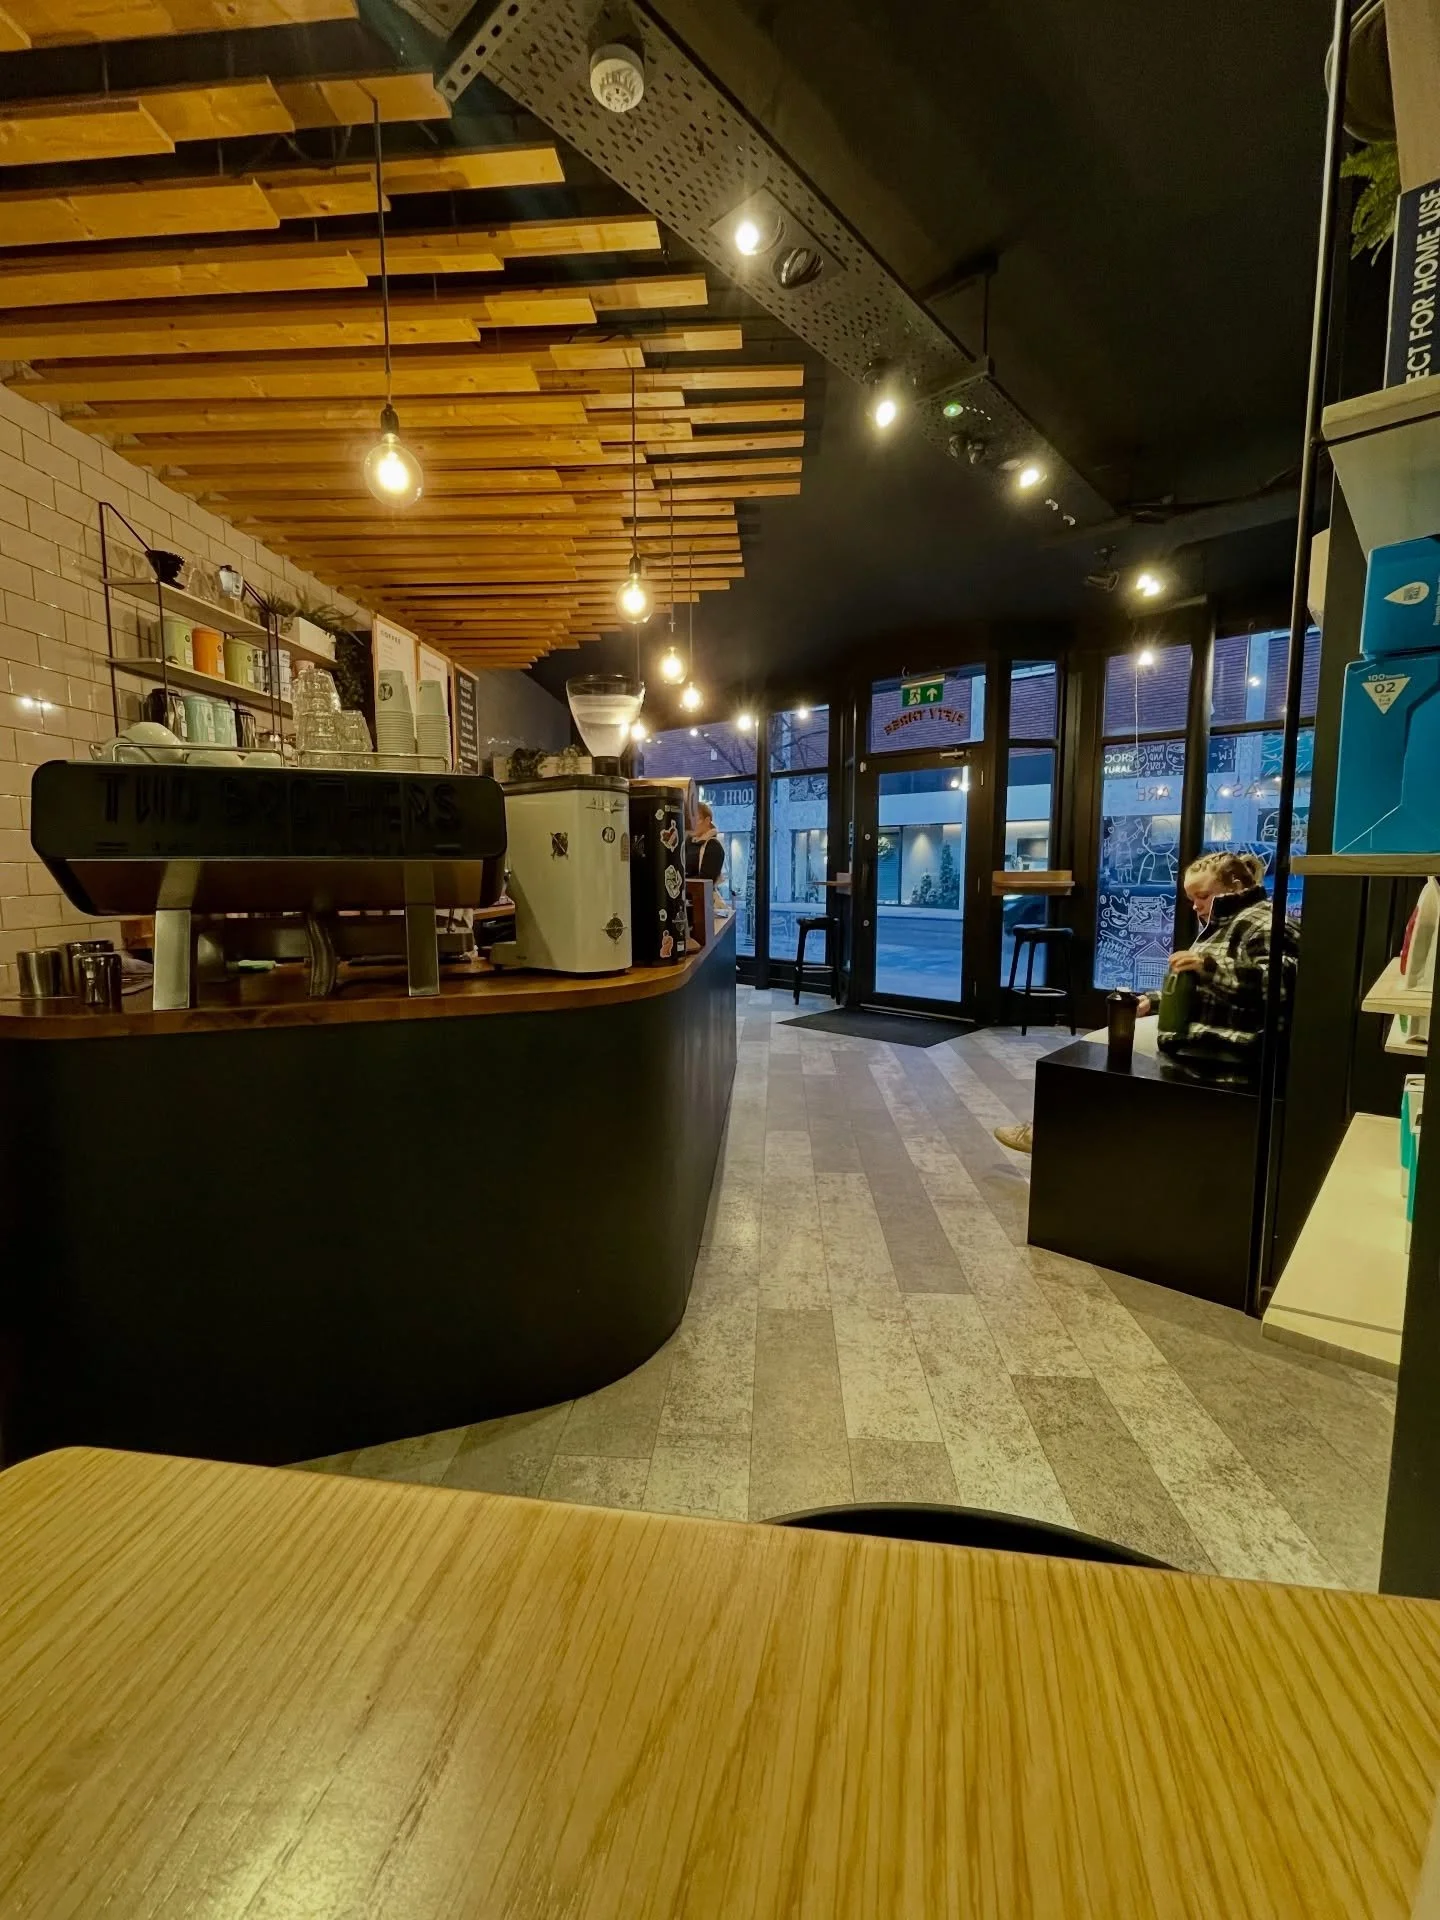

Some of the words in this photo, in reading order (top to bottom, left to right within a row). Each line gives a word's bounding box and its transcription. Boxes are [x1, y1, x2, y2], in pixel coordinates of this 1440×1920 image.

[1418, 185, 1440, 227] USE
[1413, 227, 1440, 295] HOME
[1409, 295, 1435, 341] FOR
[1367, 673, 1386, 681] 100
[1374, 682, 1396, 693] 02
